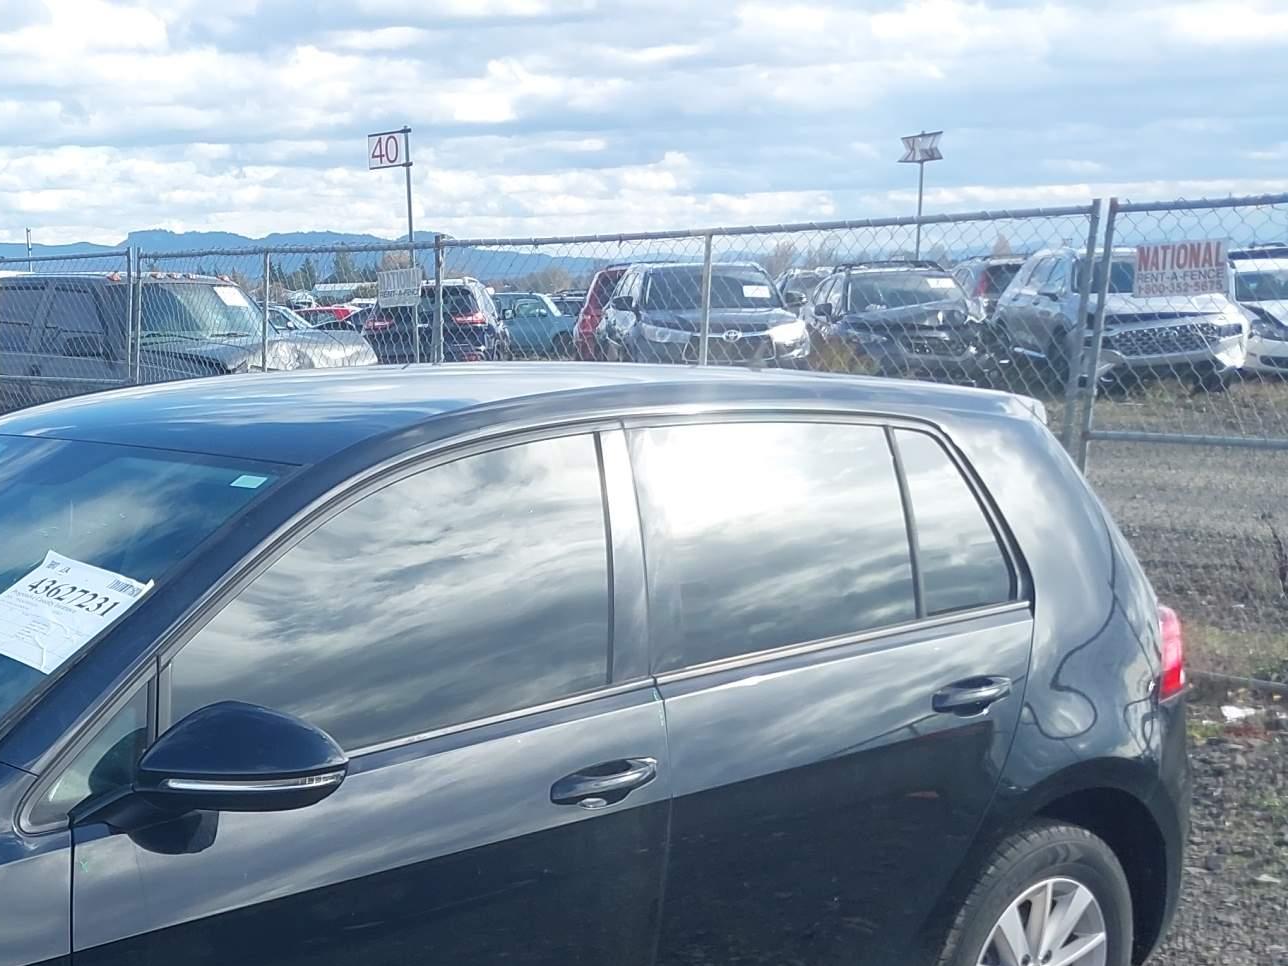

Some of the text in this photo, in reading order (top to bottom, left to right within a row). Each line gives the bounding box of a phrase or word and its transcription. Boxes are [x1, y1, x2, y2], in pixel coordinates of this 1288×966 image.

[371, 135, 399, 164] 40
[1137, 241, 1225, 272] NATIONAL
[1137, 268, 1224, 284] RENT-A-FENCE
[28, 577, 120, 617] 43627231
